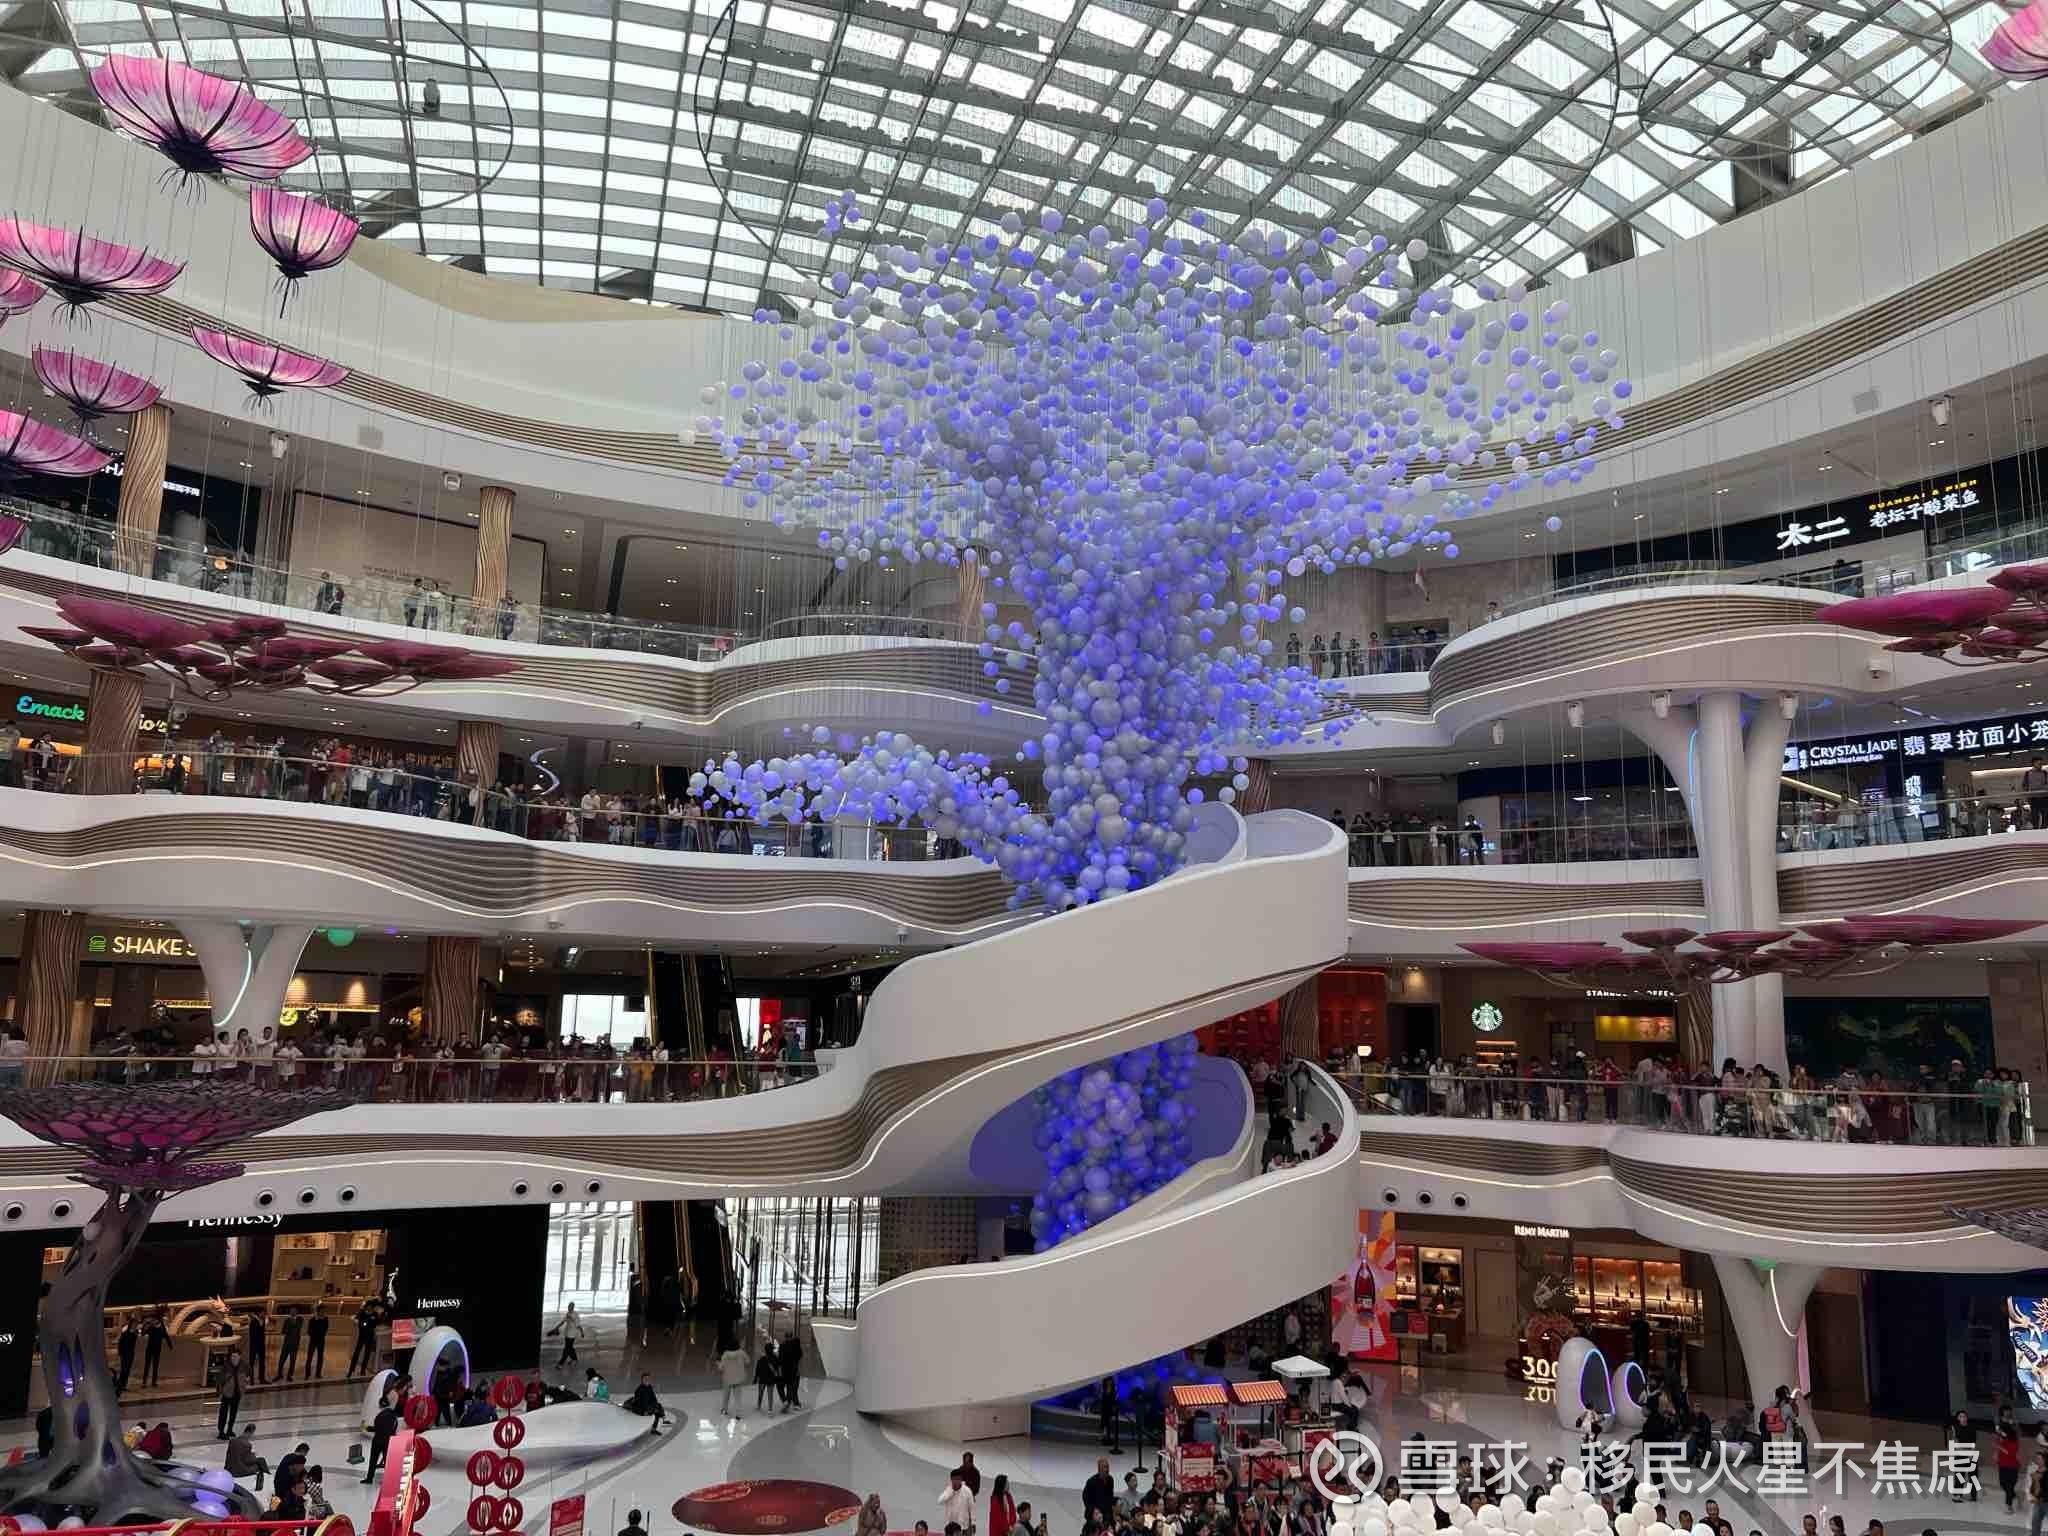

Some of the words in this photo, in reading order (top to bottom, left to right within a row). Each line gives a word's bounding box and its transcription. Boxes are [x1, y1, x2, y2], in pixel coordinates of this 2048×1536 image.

[1869, 488, 1980, 528] 老坛子酸菜鱼
[1776, 515, 1851, 550] 太二
[16, 695, 86, 721] Emack
[1810, 743, 1866, 759] CRYSTAL
[1866, 739, 1898, 754] JADE
[112, 936, 184, 956] SHAKE
[1537, 1226, 1569, 1238] MARTIN
[417, 1297, 462, 1309] Hennessy
